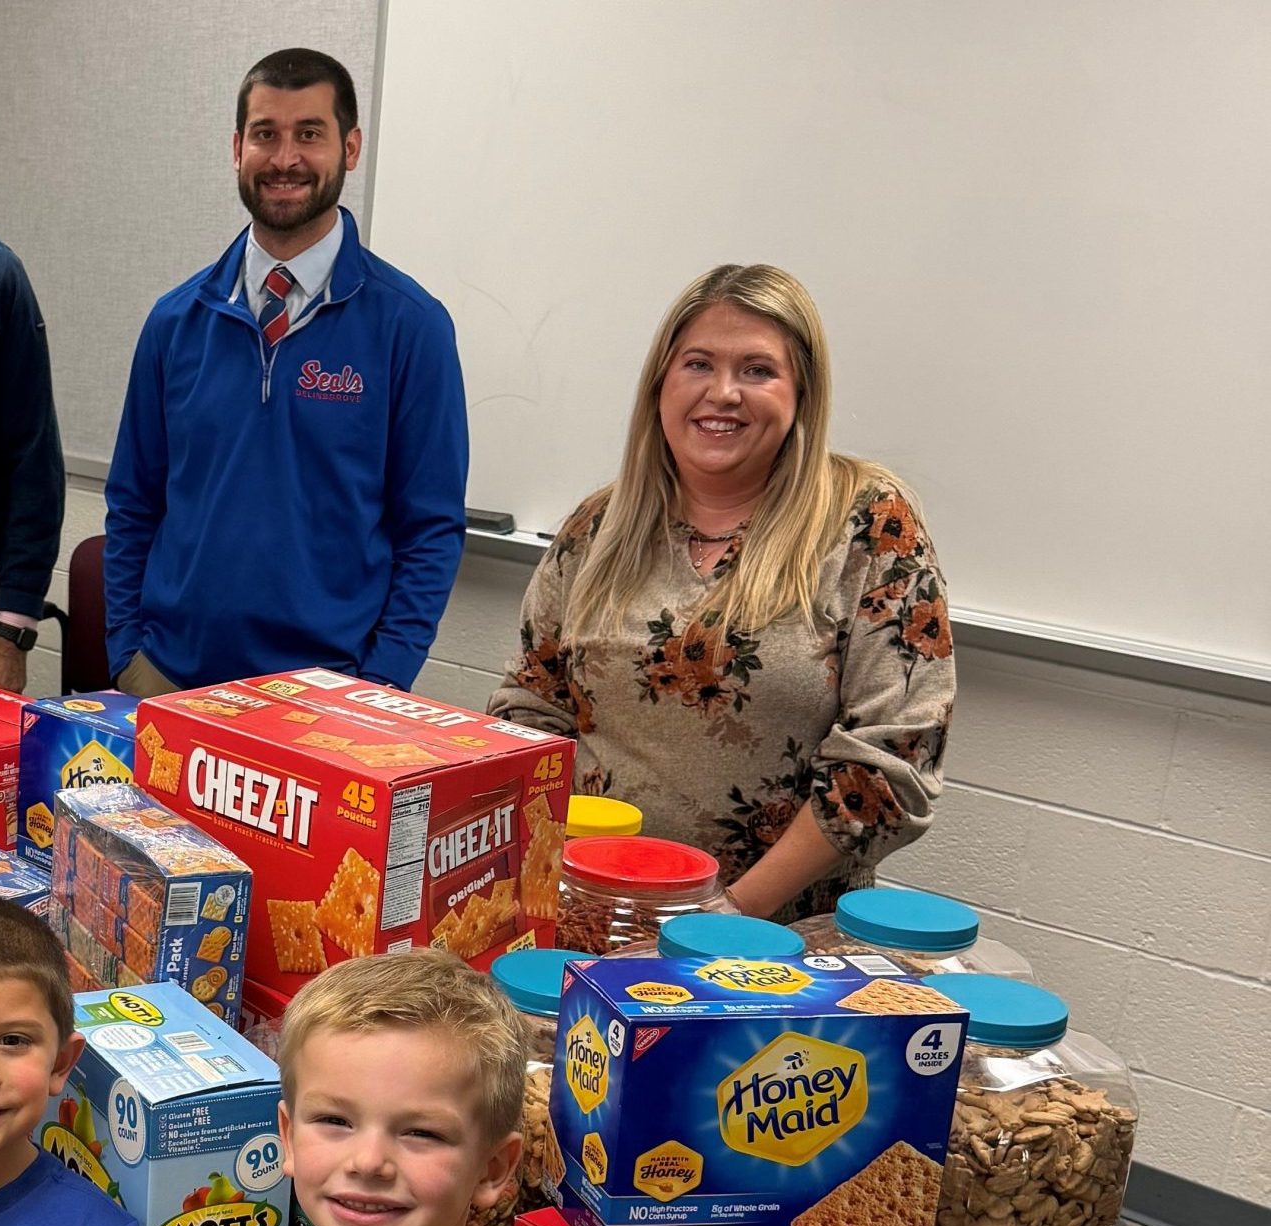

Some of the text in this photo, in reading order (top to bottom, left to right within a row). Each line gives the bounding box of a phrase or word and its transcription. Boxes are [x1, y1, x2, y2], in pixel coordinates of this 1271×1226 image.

[297, 359, 363, 393] Seals
[533, 752, 563, 781] 45
[342, 780, 376, 814] 45
[29, 820, 54, 838] Honey
[255, 832, 285, 850] crackers
[167, 936, 184, 973] Pack
[708, 964, 791, 981] Honey
[632, 988, 686, 998] Honey
[115, 996, 159, 1024] MOTT'S
[640, 1005, 661, 1014] NO
[612, 1023, 620, 1039] 4
[636, 1030, 659, 1050] NABISCO
[921, 1029, 943, 1051] 4
[567, 1034, 607, 1079] Honey
[914, 1051, 949, 1061] BOXES
[918, 1060, 943, 1068] INSIDE
[572, 1065, 601, 1095] Maid
[723, 1063, 858, 1119] Honey
[115, 1092, 138, 1129] 90
[168, 1106, 209, 1121] Gluten FREE
[746, 1094, 840, 1145] Maid
[168, 1115, 211, 1131] Gelatin FREE
[168, 1120, 272, 1140] NO colors from artificial sources
[117, 1126, 138, 1142] COUNT
[167, 1138, 198, 1148] Excellent
[199, 1135, 222, 1144] Source
[167, 1145, 195, 1153] Vitamin
[245, 1141, 279, 1171] 90
[583, 1144, 605, 1175] Honey
[672, 1155, 689, 1163] WITH
[251, 1161, 280, 1179] COUNT
[640, 1165, 697, 1184] Honey
[629, 1204, 698, 1220] NO High Fructose
[648, 1212, 688, 1222] Corn Syrup
[711, 1203, 780, 1214] 8g of Whole Grain
